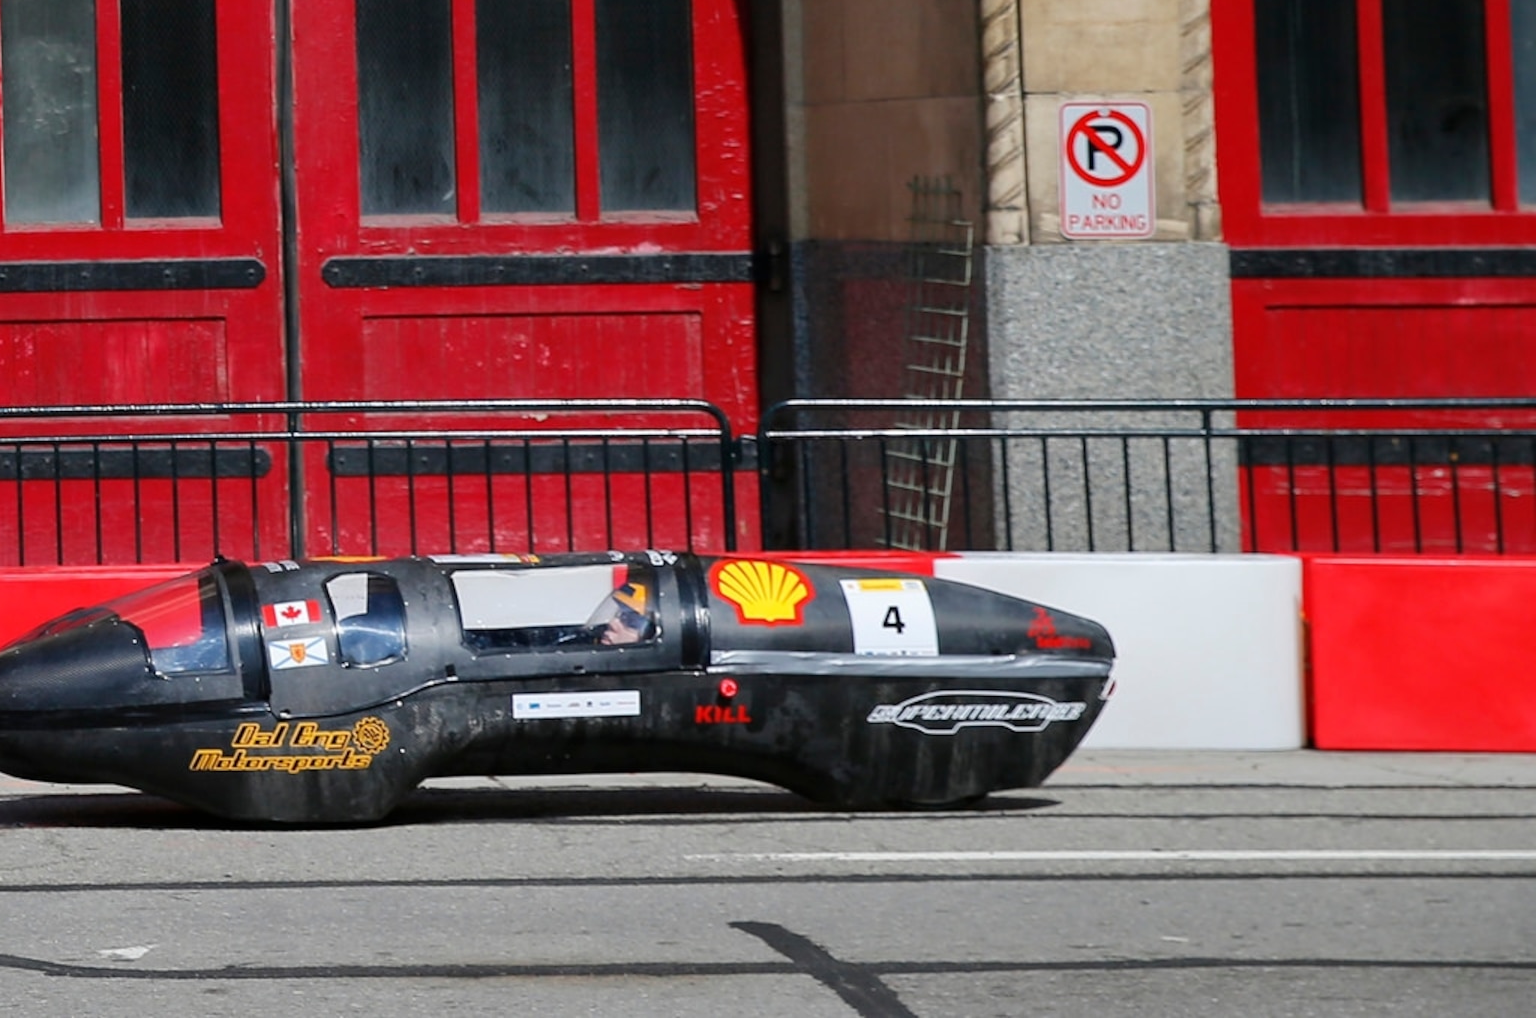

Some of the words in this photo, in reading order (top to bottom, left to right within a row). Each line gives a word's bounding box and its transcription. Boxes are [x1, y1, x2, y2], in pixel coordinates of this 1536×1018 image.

[1092, 194, 1122, 210] NO
[1069, 214, 1147, 230] PARKING
[882, 606, 905, 634] 4
[695, 704, 751, 724] KILL
[231, 722, 289, 748] Dal
[289, 722, 353, 751] Eng
[189, 748, 372, 774] Motorsports
